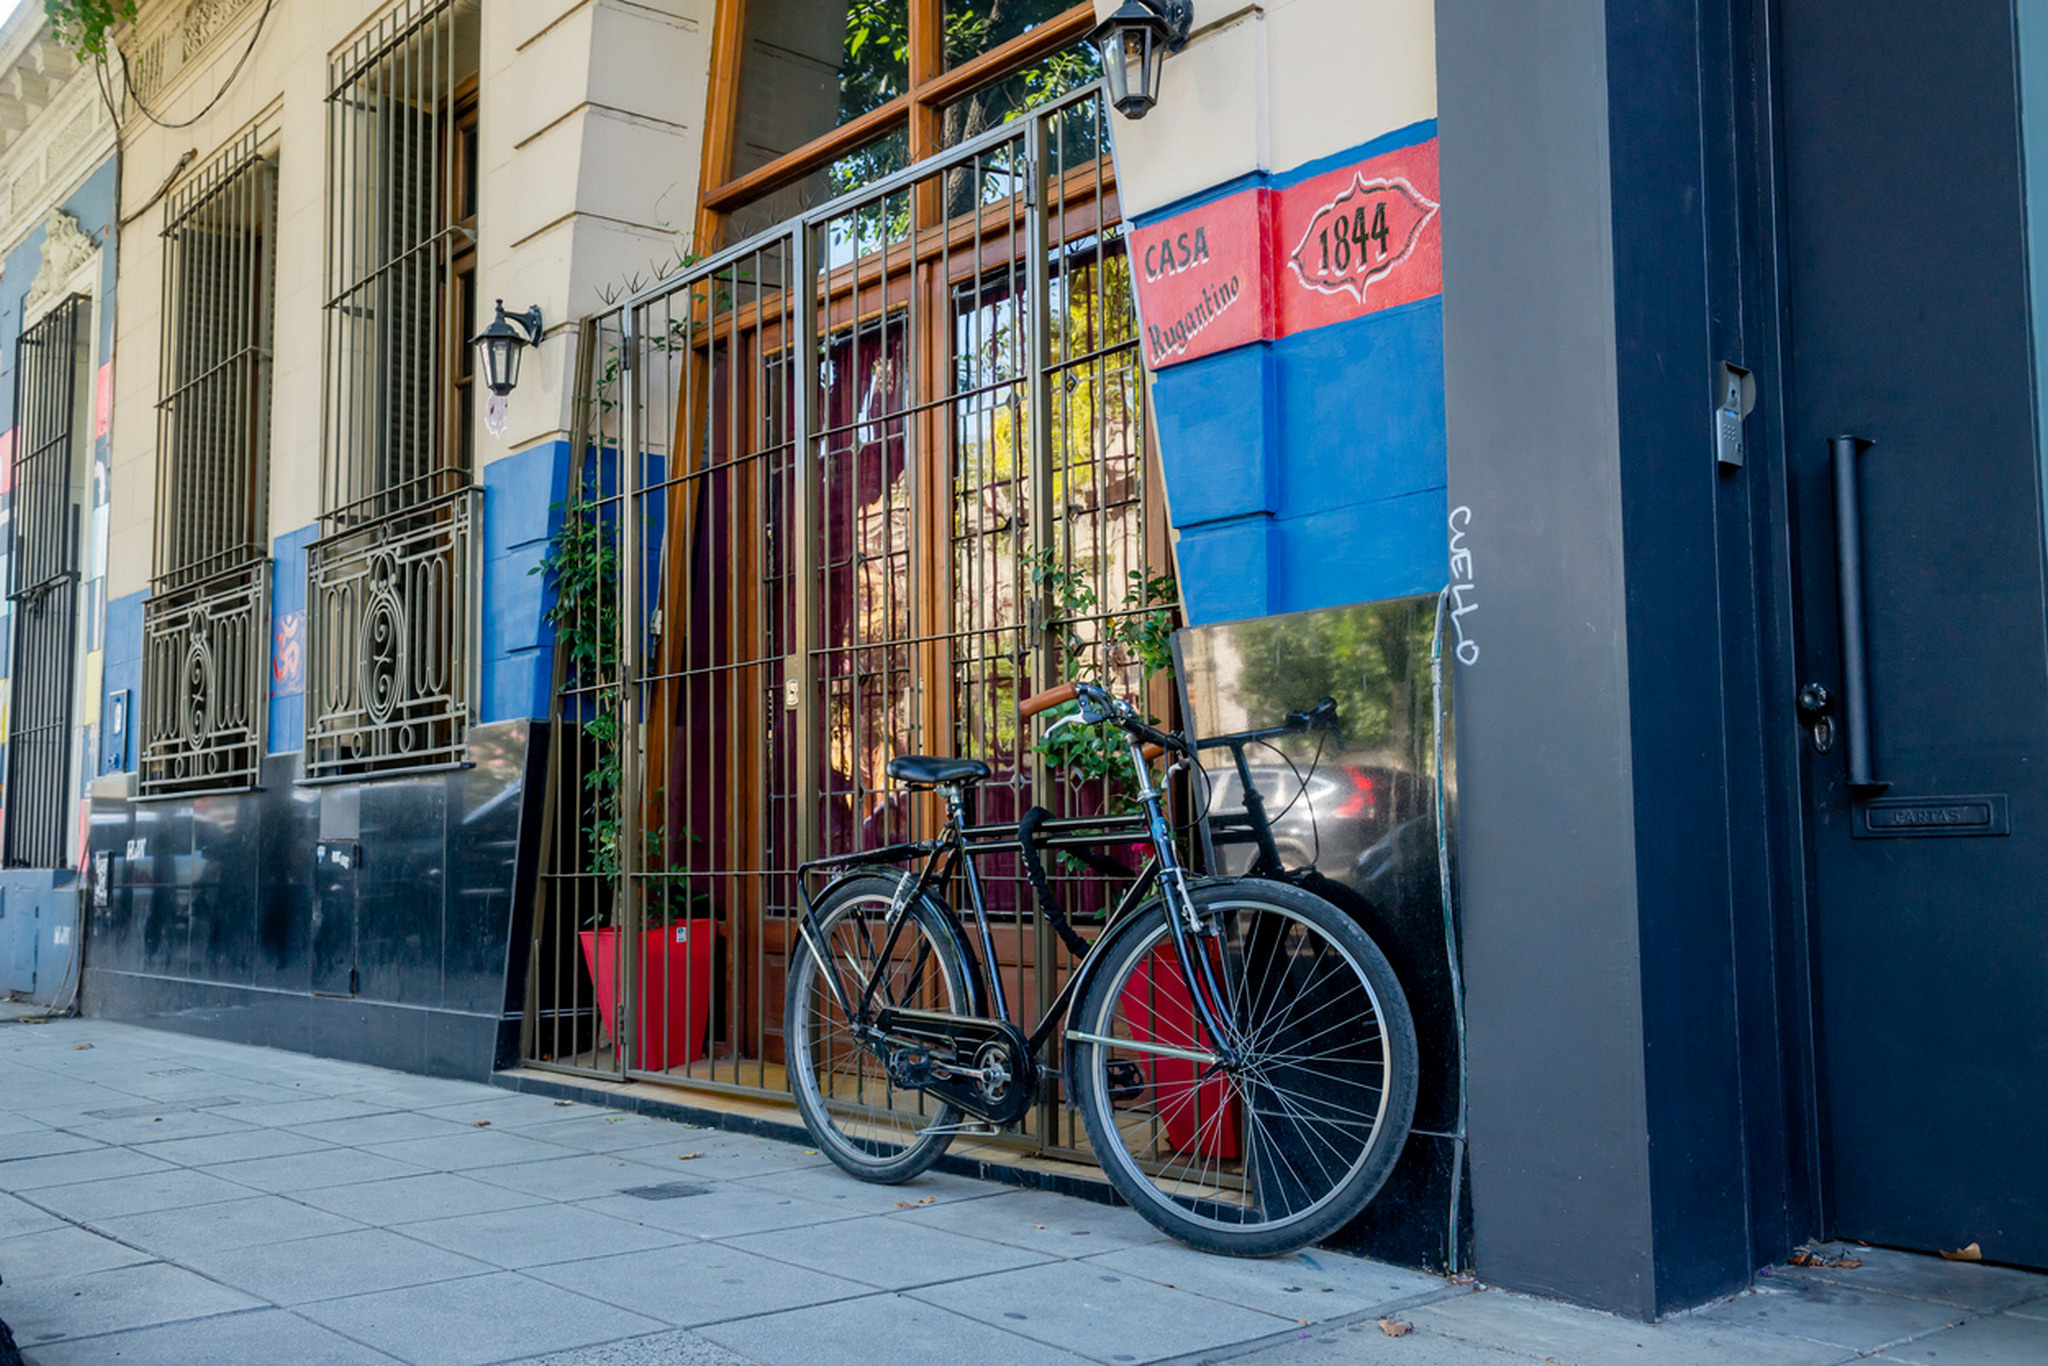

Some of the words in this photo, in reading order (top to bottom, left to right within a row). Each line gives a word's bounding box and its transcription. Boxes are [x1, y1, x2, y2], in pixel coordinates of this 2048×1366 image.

[1145, 226, 1210, 281] CASA
[1318, 202, 1390, 274] 1844
[1147, 274, 1240, 363] Rugantino
[1893, 809, 1962, 825] CARTAS
